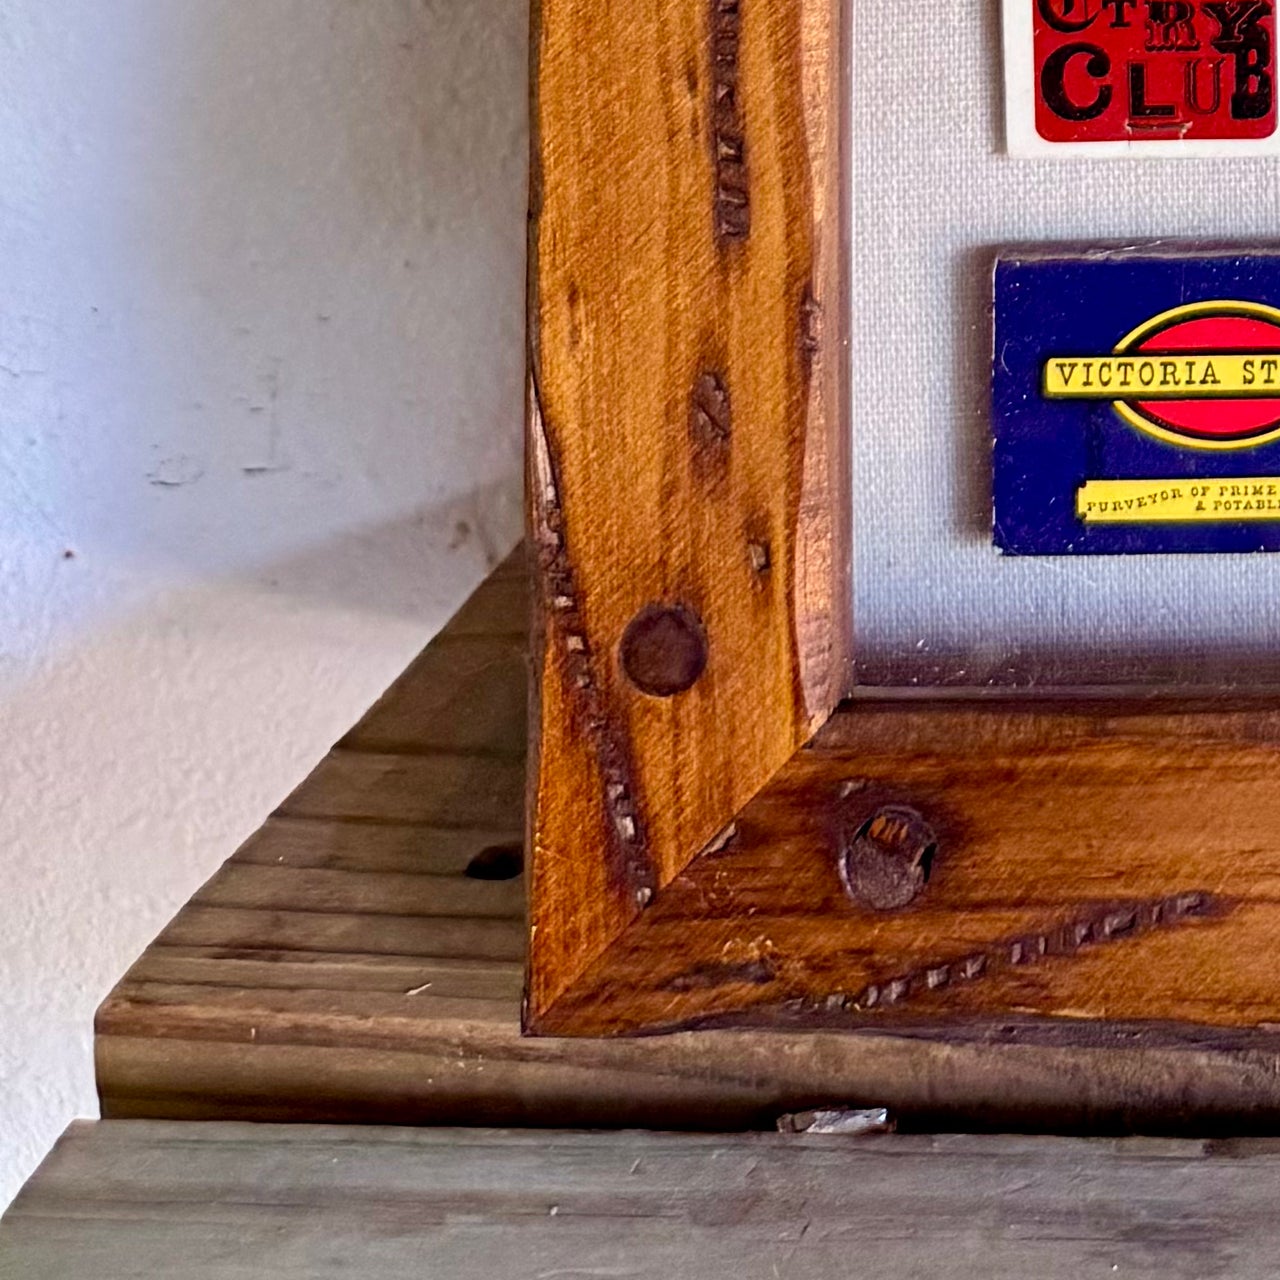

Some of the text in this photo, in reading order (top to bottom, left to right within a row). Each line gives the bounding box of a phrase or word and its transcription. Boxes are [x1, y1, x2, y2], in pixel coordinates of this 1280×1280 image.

[1055, 359, 1220, 387] VICTORIA
[1086, 488, 1183, 513] PURVEYOR
[1191, 486, 1208, 497] OF
[1219, 485, 1276, 497] PRIME
